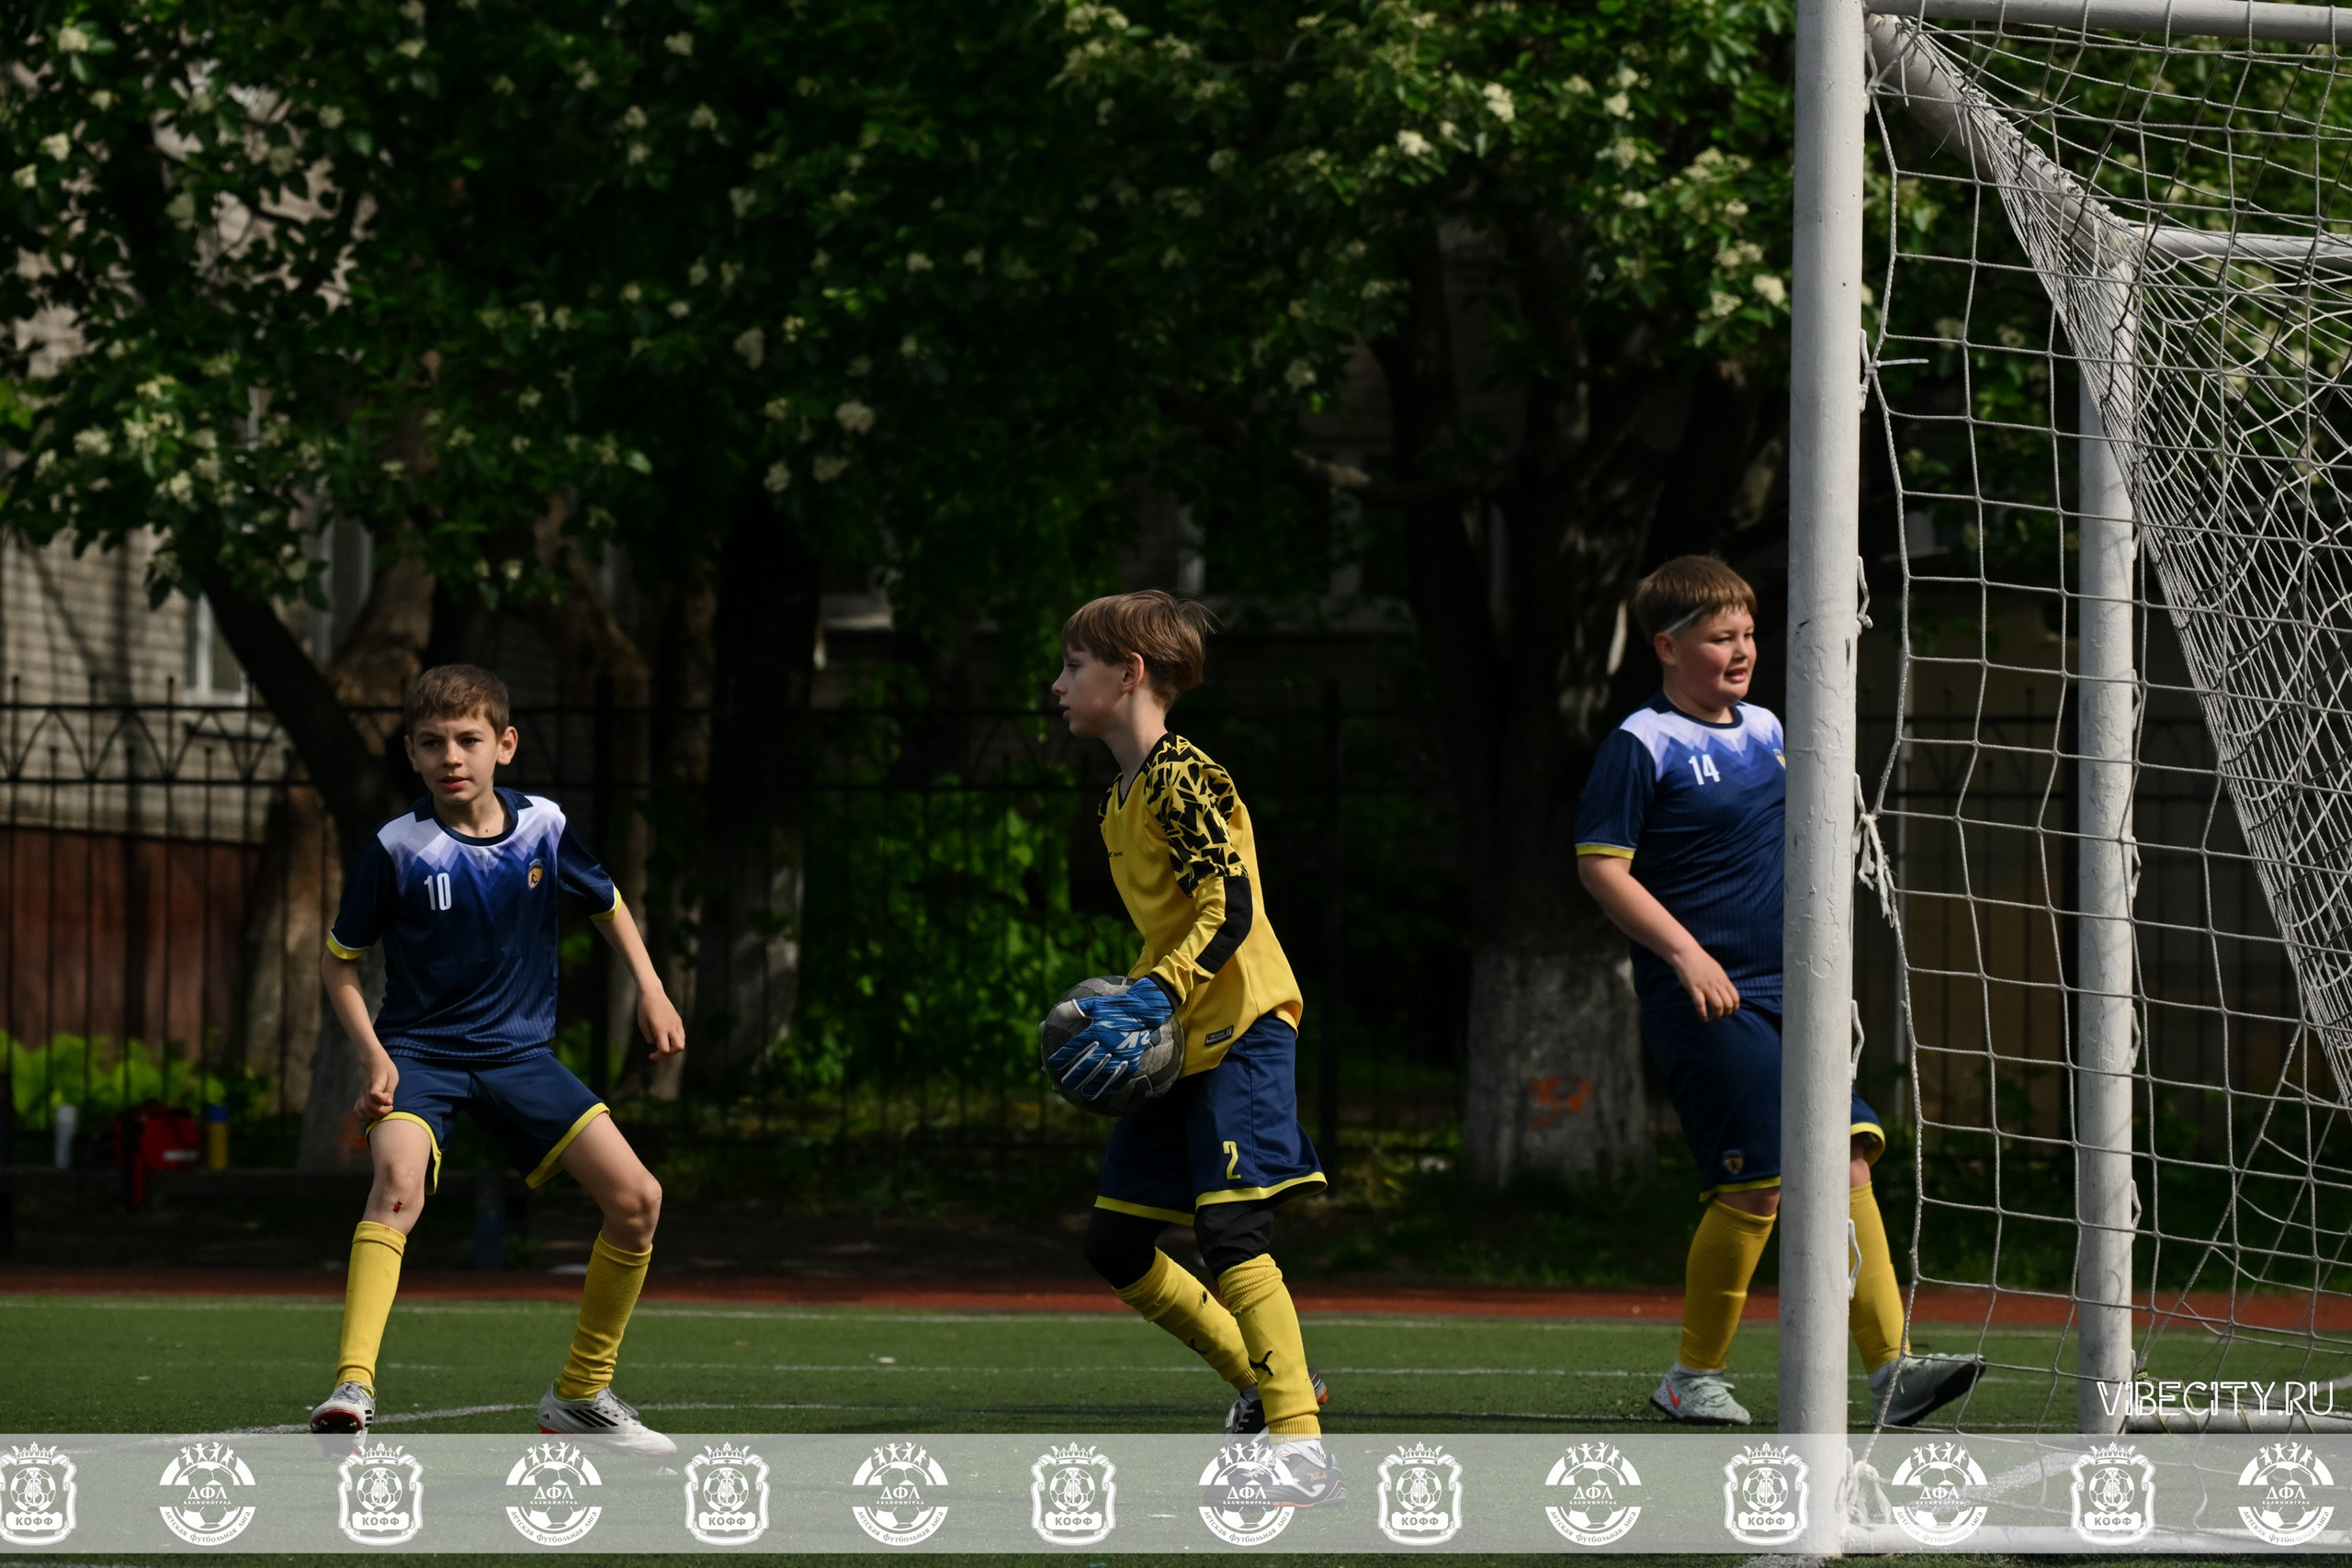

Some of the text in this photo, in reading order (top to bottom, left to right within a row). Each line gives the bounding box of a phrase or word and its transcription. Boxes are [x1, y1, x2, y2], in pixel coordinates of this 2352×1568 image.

[1688, 753, 1721, 785] 14
[424, 872, 452, 911] 10
[1223, 1140, 1241, 1180] 2
